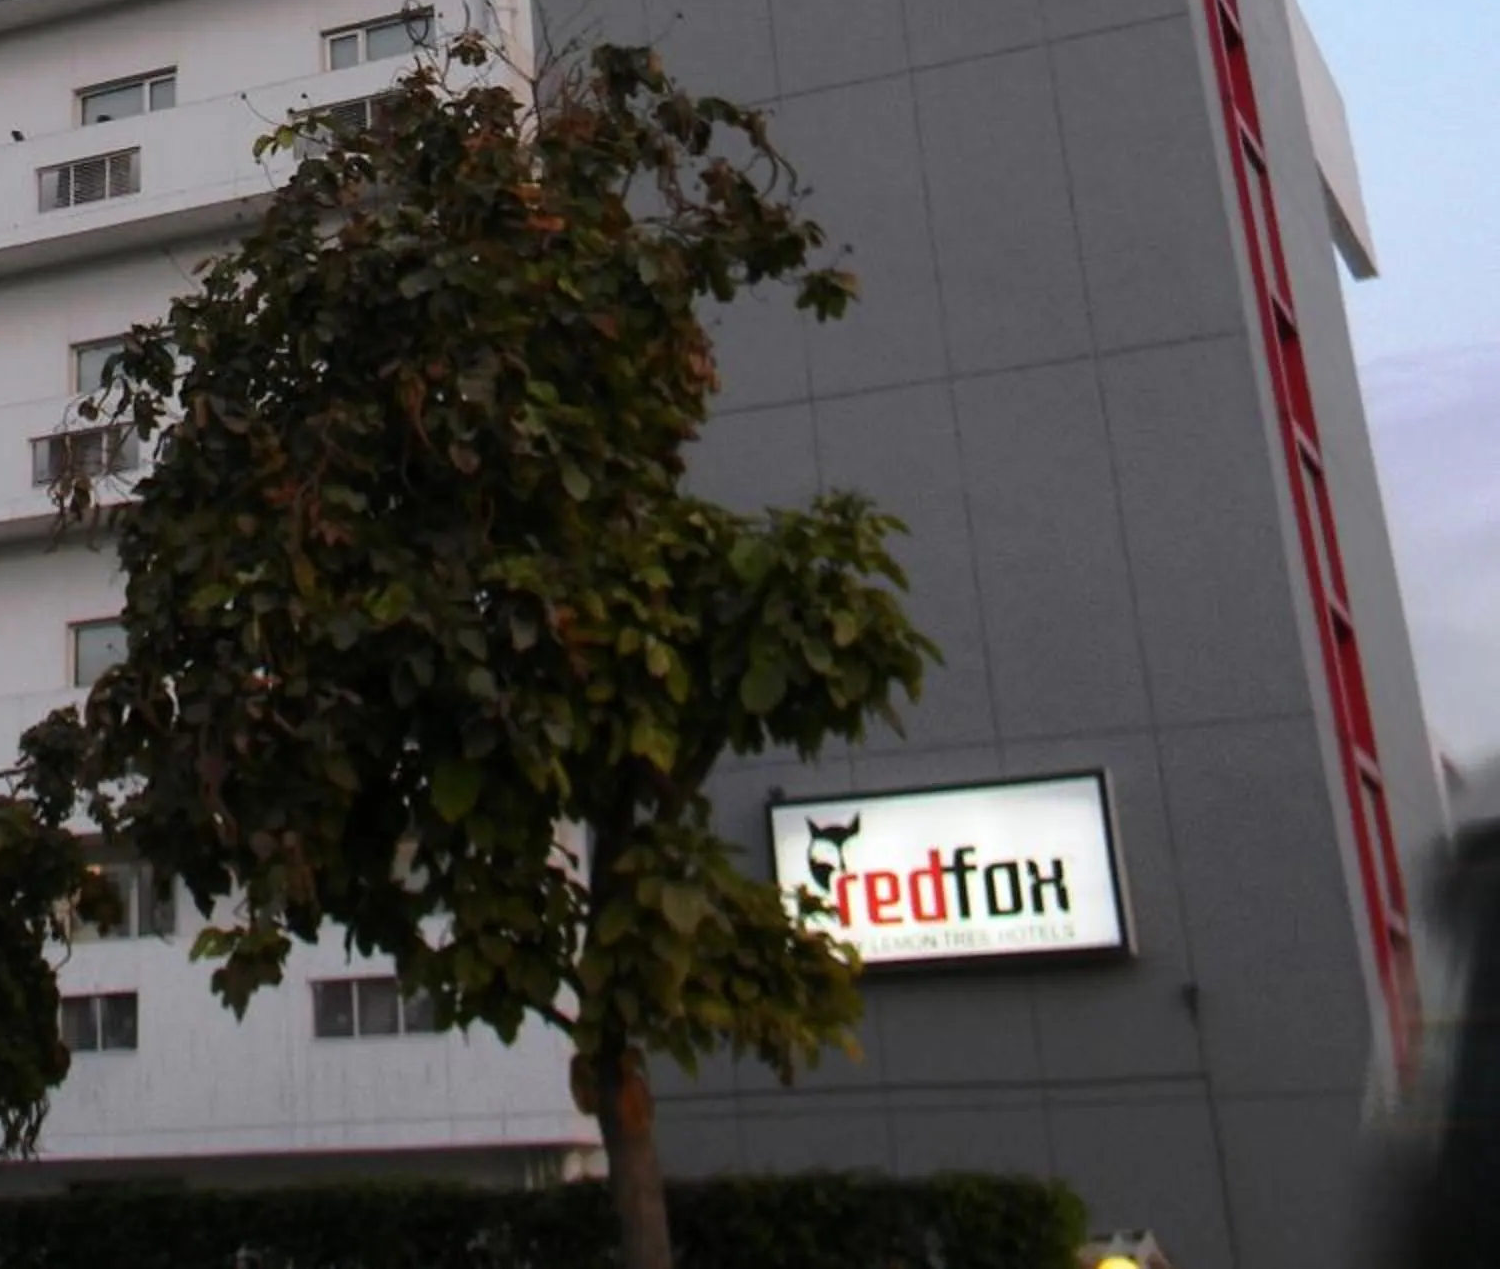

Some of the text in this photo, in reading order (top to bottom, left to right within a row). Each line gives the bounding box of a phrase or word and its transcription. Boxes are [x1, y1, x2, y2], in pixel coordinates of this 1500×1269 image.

[836, 845, 1071, 927] redfox
[944, 928, 990, 948] TREE
[999, 923, 1076, 943] HOTELS
